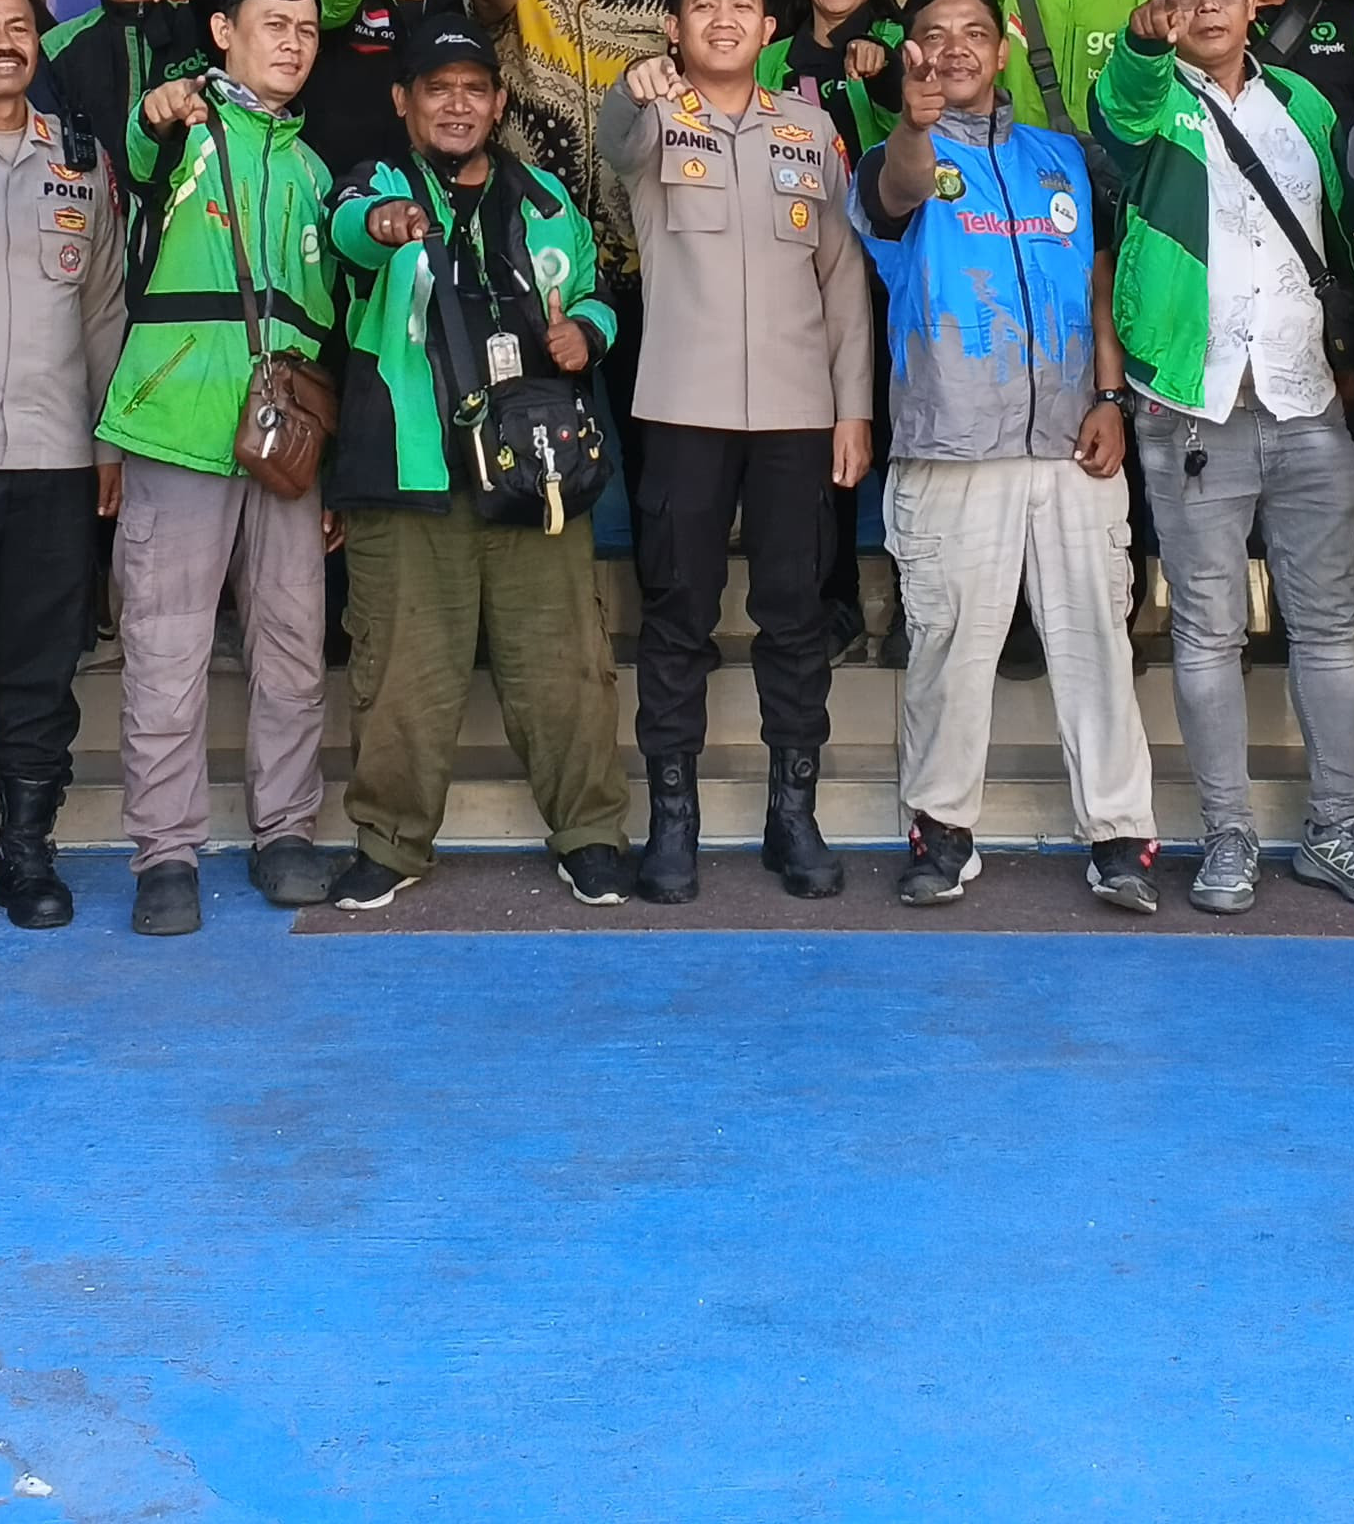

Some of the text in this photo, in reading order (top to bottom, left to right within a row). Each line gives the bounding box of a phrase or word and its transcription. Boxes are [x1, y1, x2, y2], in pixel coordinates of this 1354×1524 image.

[665, 128, 723, 155] DANIEL
[769, 143, 822, 167] POLRI
[43, 181, 94, 202] POLRI
